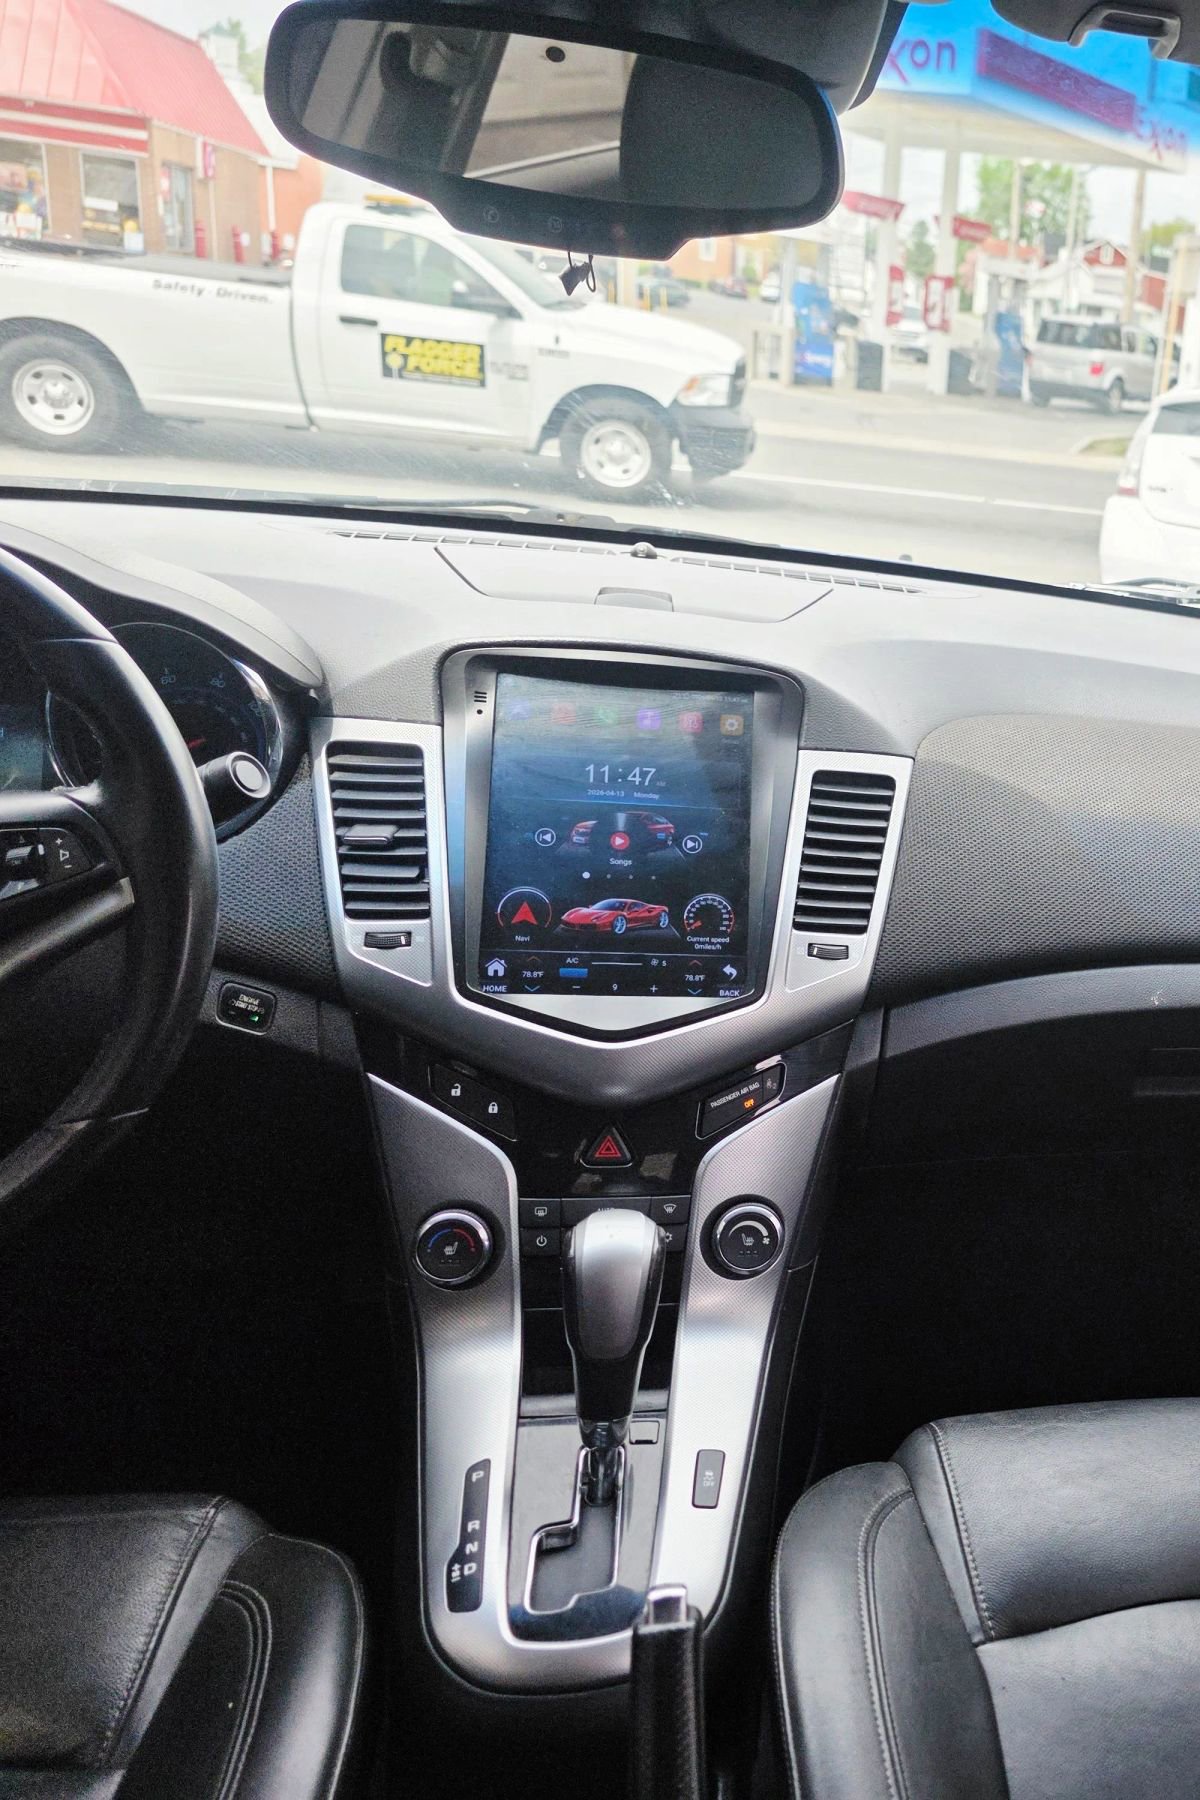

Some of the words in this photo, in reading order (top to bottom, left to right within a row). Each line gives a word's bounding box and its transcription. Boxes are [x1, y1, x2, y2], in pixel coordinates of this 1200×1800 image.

[384, 335, 481, 362] FLAGGER
[585, 763, 657, 787] 11:47
[633, 791, 660, 801] Monday
[609, 857, 633, 867] Songs
[686, 935, 710, 943] Current
[710, 936, 730, 944] speed
[482, 985, 508, 993] HOME
[719, 989, 740, 997] BACK
[710, 1090, 741, 1109] PASSENGER
[740, 1087, 750, 1095] AIR
[749, 1082, 760, 1091] BAG
[744, 1099, 755, 1109] OFF
[472, 1470, 484, 1483] P
[467, 1520, 480, 1533] R
[466, 1541, 479, 1555] N
[463, 1562, 477, 1576] D
